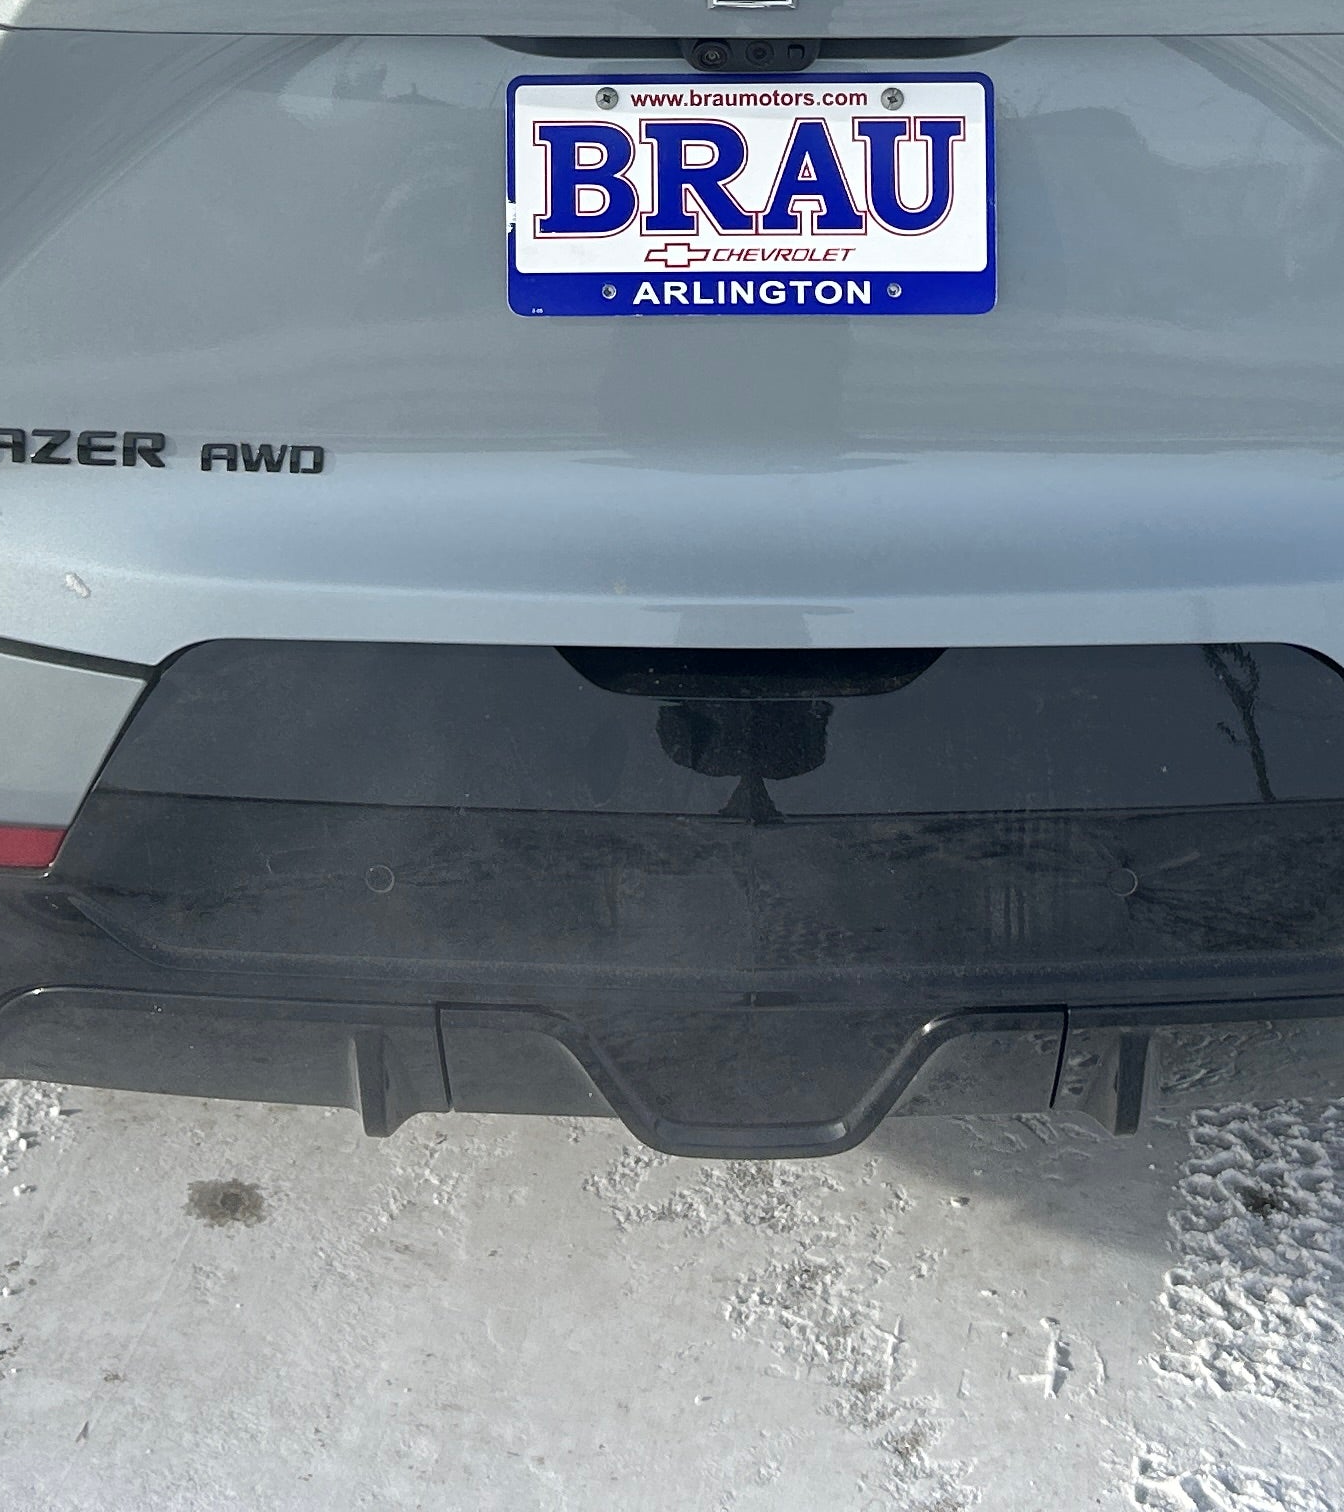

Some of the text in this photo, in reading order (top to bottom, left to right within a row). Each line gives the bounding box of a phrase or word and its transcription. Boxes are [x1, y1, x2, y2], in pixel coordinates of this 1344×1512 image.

[631, 89, 868, 108] www.braumotors.com
[533, 116, 965, 239] BRAU
[712, 247, 856, 263] CHEVROLET
[632, 280, 872, 306] ARLINGTON
[200, 442, 325, 474] AWD
